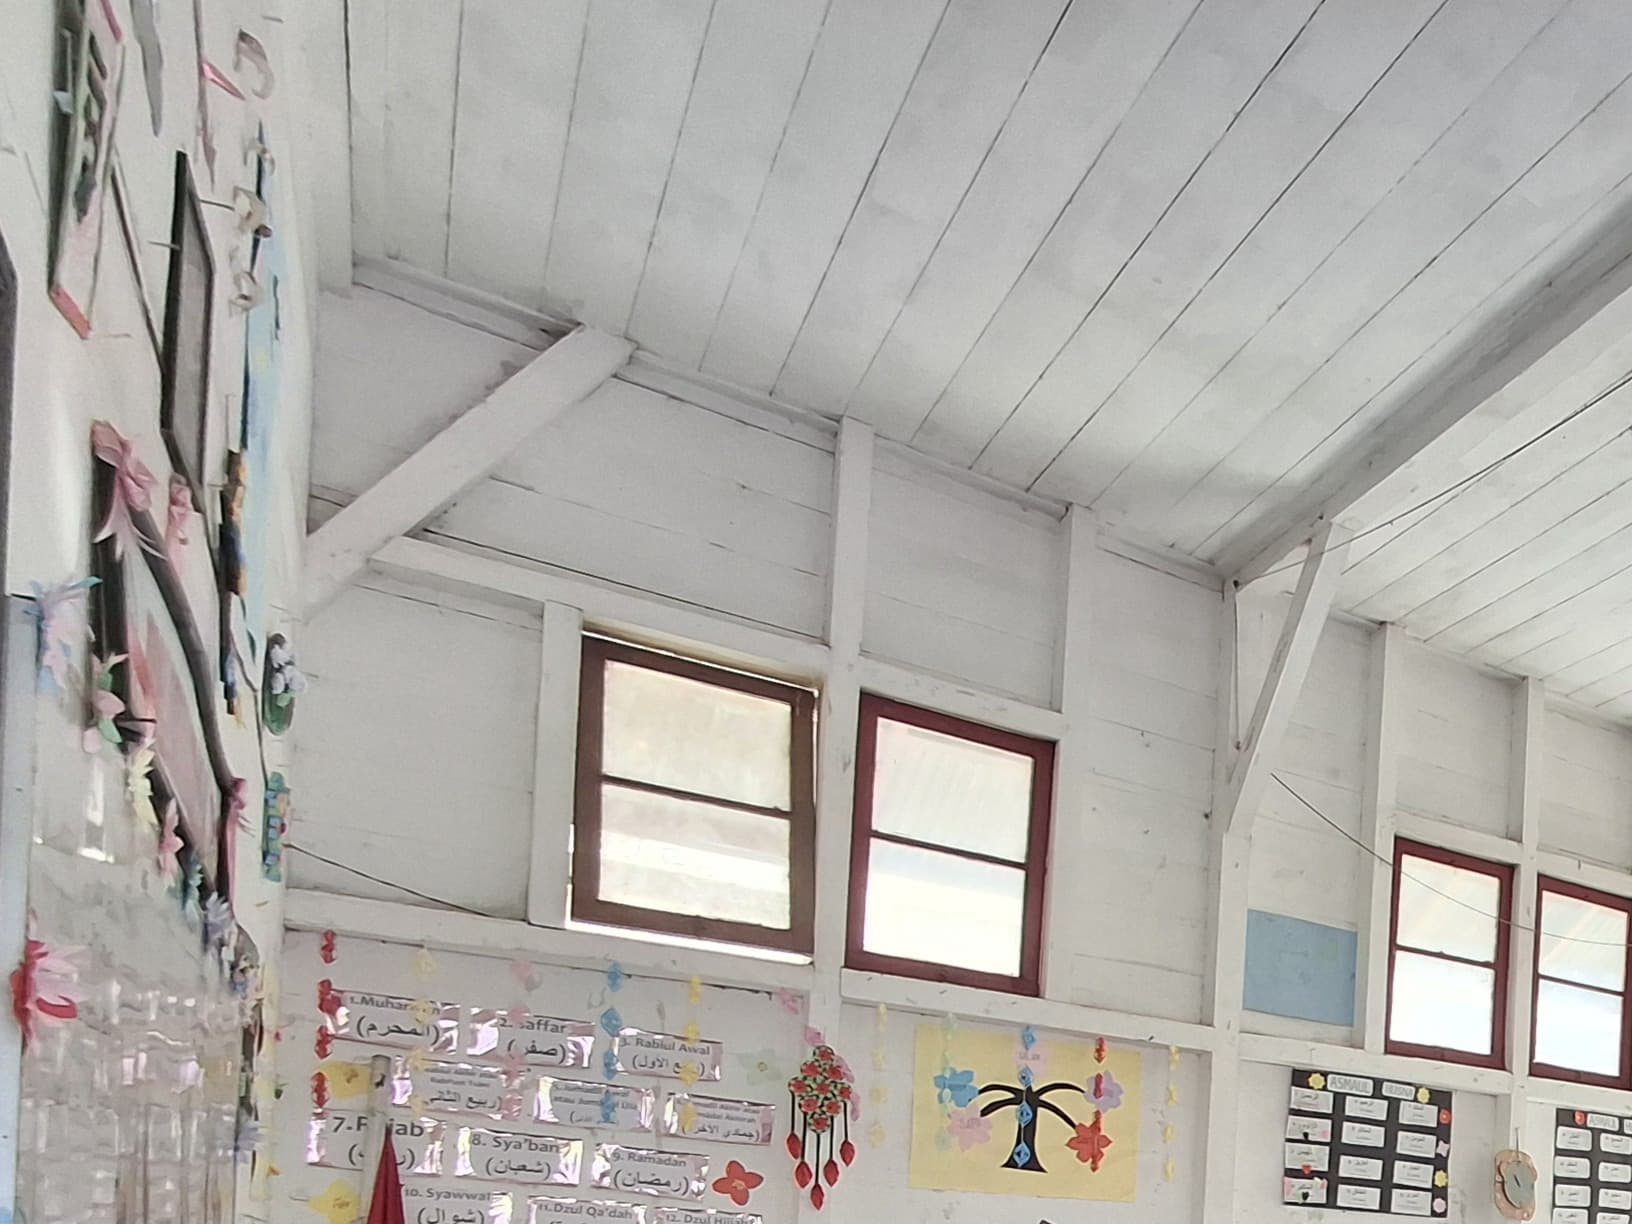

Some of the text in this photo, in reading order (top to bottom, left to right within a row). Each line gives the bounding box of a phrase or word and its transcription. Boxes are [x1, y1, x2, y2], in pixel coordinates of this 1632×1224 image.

[518, 1019, 568, 1034] affar
[635, 1038, 676, 1051] Rabiul
[678, 1043, 711, 1055] Awal
[471, 1134, 487, 1146] 8.
[612, 1149, 687, 1167] 9. Ramadan
[613, 1169, 690, 1196] (رمضان)
[426, 1187, 490, 1201] Syawwal
[684, 1214, 711, 1224] Dzul
